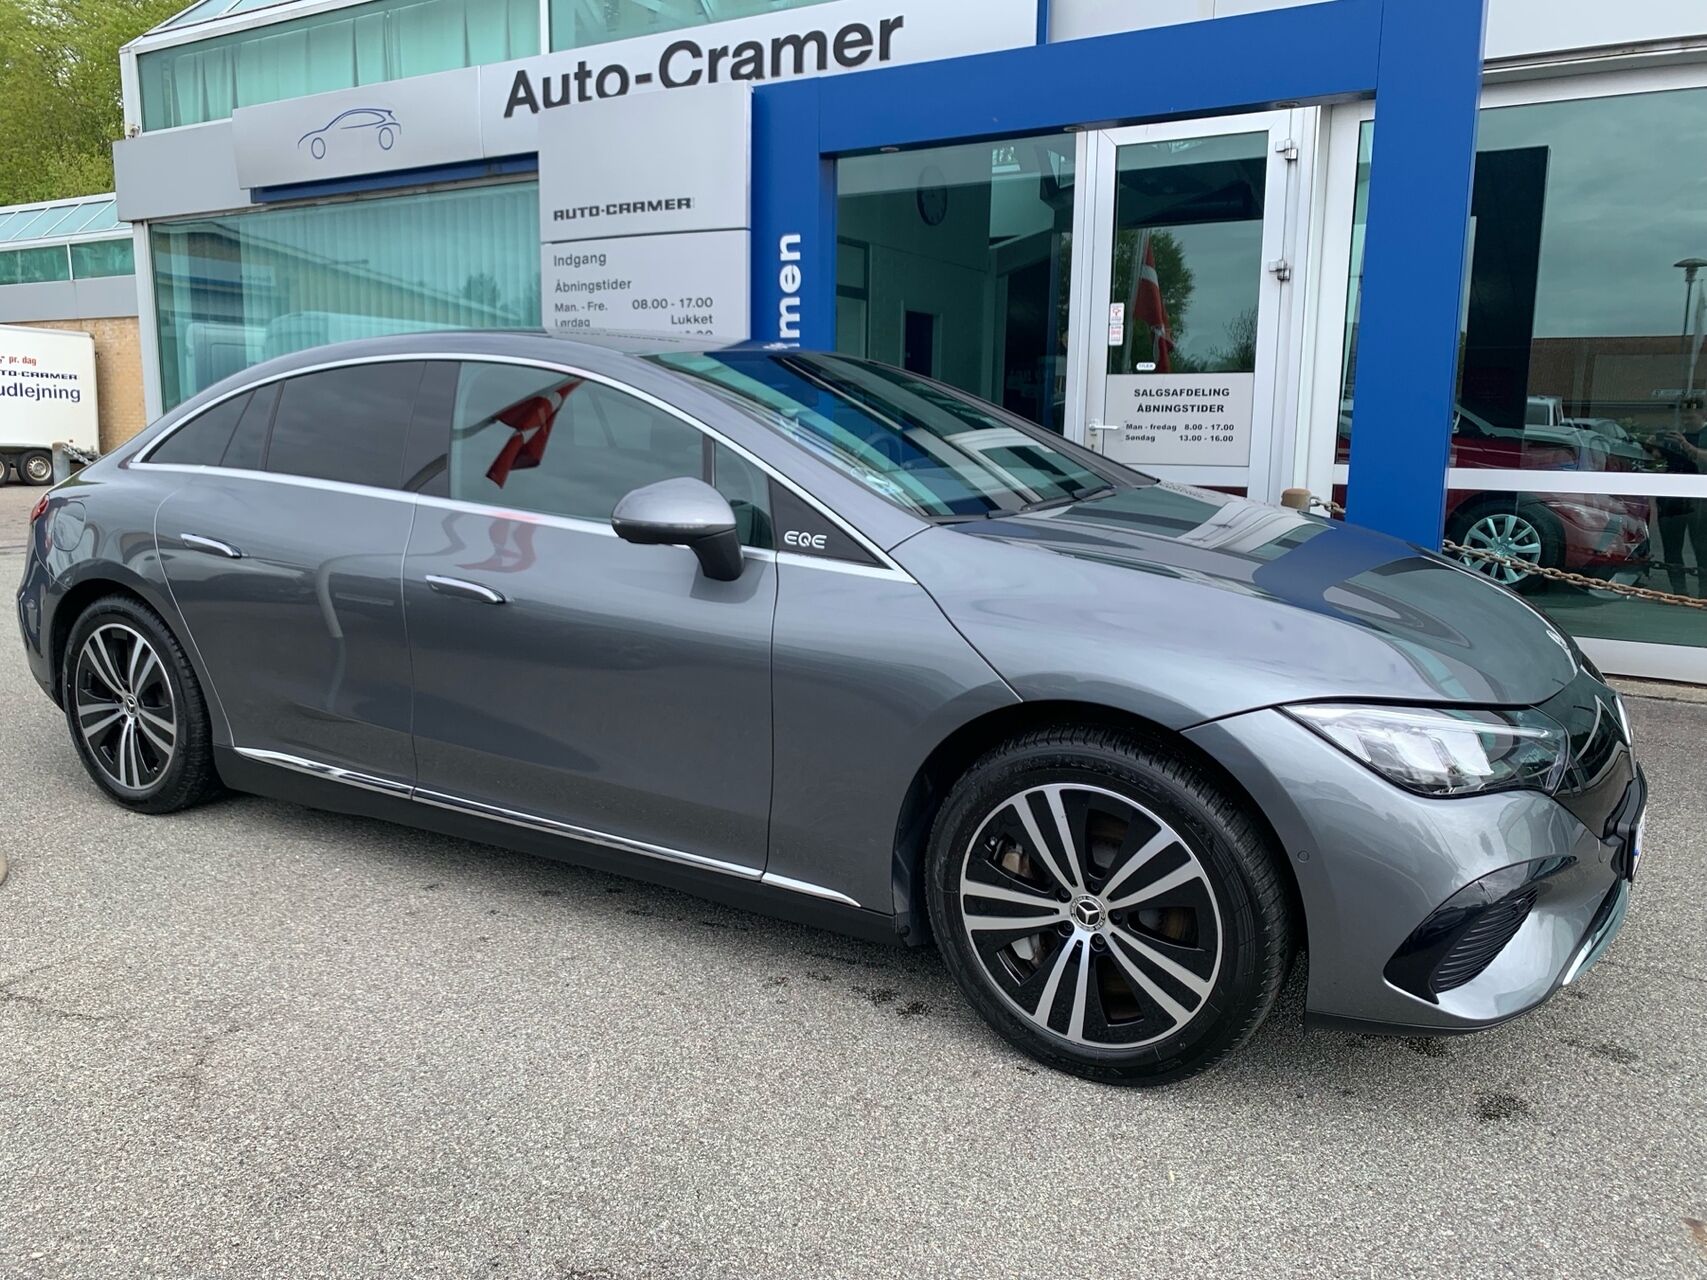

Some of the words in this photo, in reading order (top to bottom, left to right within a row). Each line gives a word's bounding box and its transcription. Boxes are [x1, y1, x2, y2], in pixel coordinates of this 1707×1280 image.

[504, 15, 904, 118] Auto-Cramer
[553, 253, 607, 268] Indgang
[554, 278, 632, 293] Åbningstider
[554, 303, 580, 312] Man.
[587, 301, 608, 311] Fre.
[632, 298, 668, 310] 08.00
[679, 297, 713, 308] 17.00
[671, 314, 713, 325] Lukket
[8, 356, 19, 364] pr.
[22, 356, 37, 366] dag
[1134, 388, 1230, 398] SALGSAFDELING
[1136, 403, 1224, 413] ÅBNINGSTIDER
[1126, 423, 1143, 431] Man
[1150, 423, 1177, 432] fredag
[1125, 434, 1156, 443] Søndag
[784, 530, 827, 549] EQE
